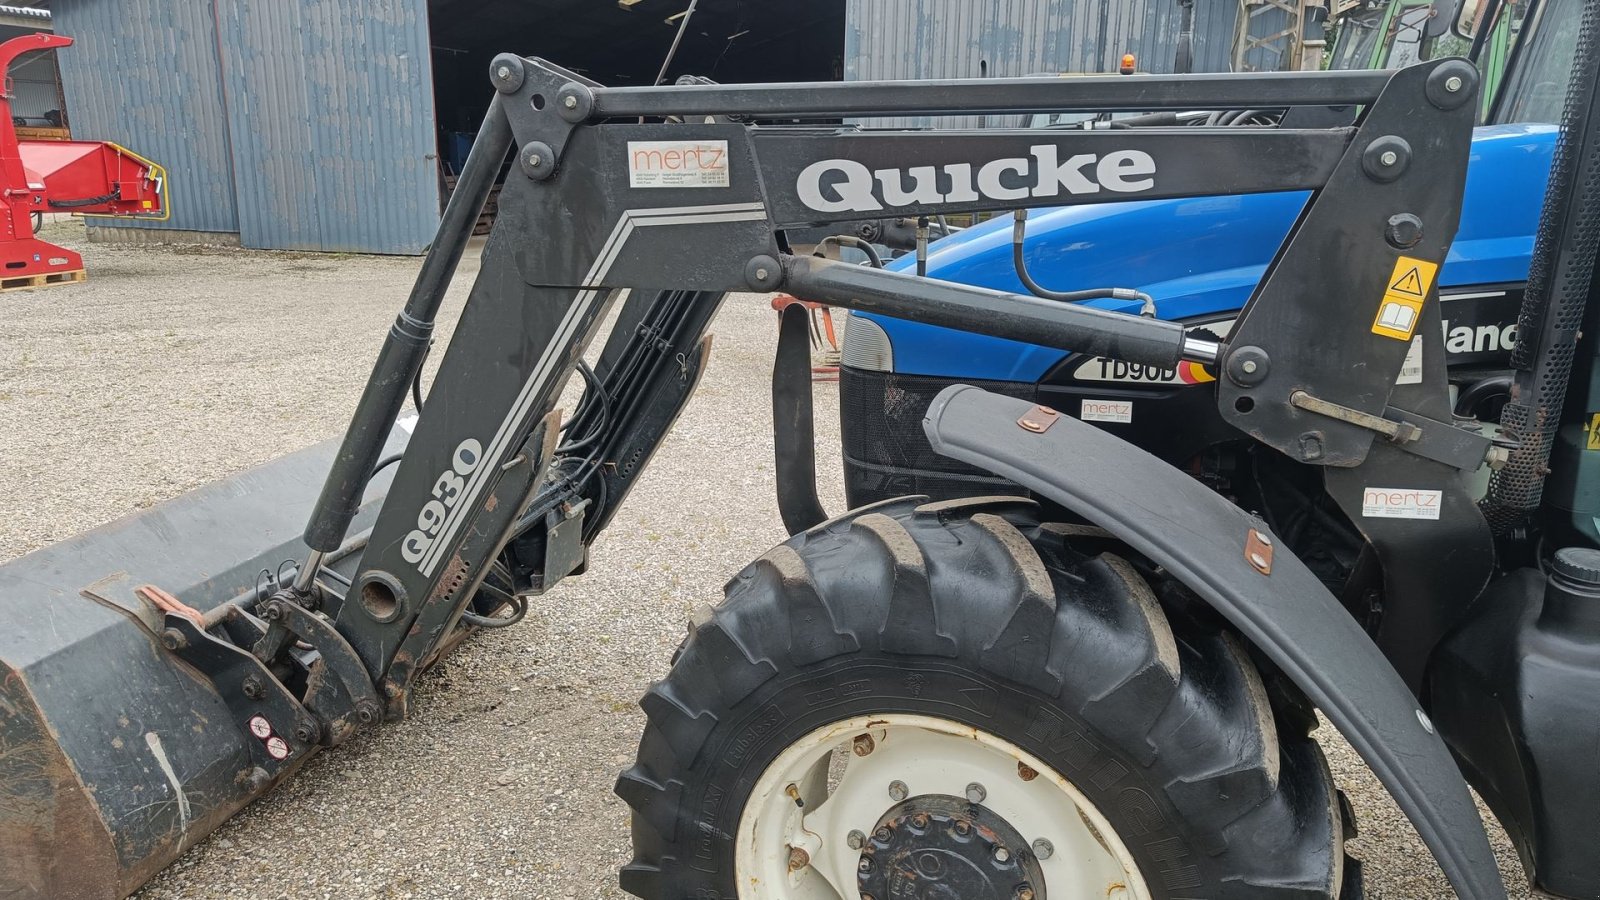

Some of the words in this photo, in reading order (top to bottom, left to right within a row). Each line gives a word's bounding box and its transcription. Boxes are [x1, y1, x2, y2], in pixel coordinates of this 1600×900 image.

[634, 145, 725, 170] mertz
[796, 144, 1156, 213] Quicke
[1097, 357, 1177, 382] TD90D
[1083, 401, 1130, 415] mertz
[401, 438, 483, 564] Q930
[1364, 491, 1438, 507] mertz
[1024, 704, 1208, 900] MICH
